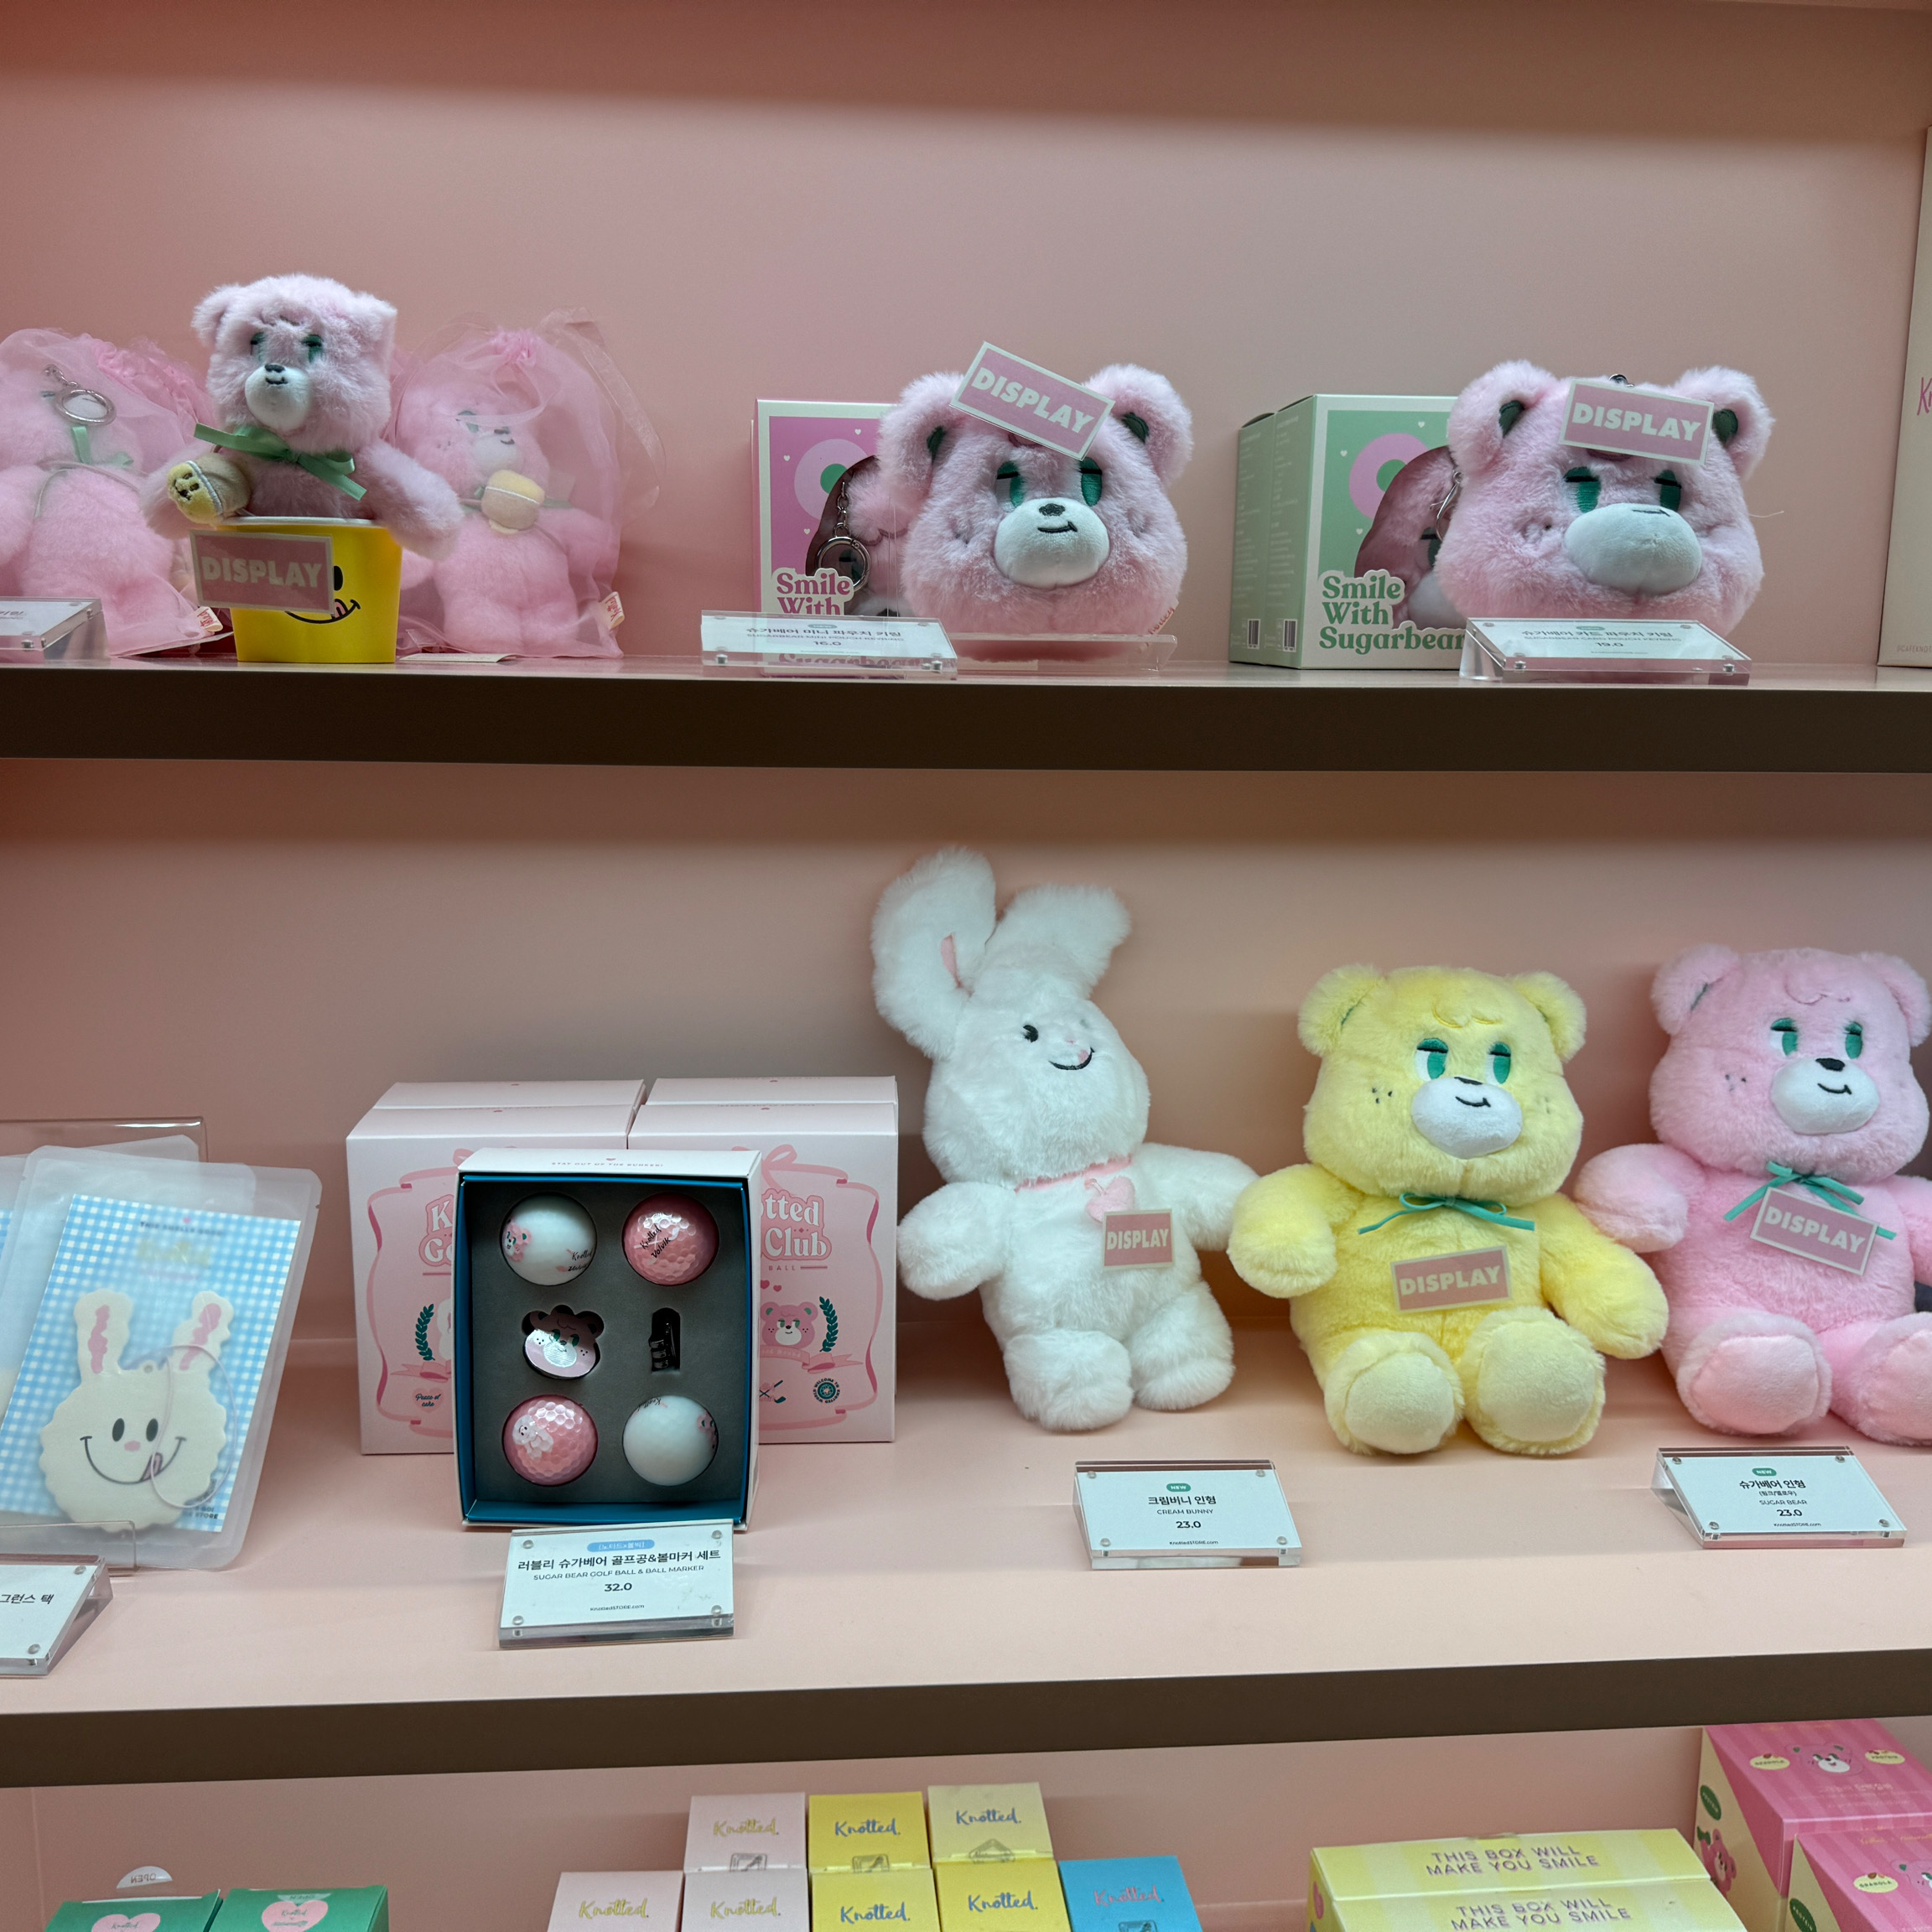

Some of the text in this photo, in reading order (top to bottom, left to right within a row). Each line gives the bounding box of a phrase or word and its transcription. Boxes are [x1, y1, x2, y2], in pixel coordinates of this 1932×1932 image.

[971, 367, 1094, 434] DISPLAY
[1572, 402, 1701, 441] DISPLAY
[201, 557, 322, 588] DISPLAY
[776, 572, 851, 595] Smile
[1322, 575, 1402, 599] Smile
[776, 596, 841, 615] With
[1322, 601, 1389, 625] With
[1319, 626, 1465, 655] Sugarbear
[640, 1223, 662, 1249] Knotted
[1107, 1228, 1170, 1250] DISPLAY
[1763, 1206, 1866, 1254] DISPLAY
[765, 1227, 827, 1257] Club
[1398, 1266, 1502, 1296] DISPLAY
[1739, 1479, 1806, 1489] 슈가베어 인형
[1148, 1495, 1217, 1506] 크림버니 인형
[1777, 1509, 1803, 1517] 23.0
[1176, 1520, 1202, 1530] 23.0
[517, 1550, 721, 1571] 러블리 슈가베어 골프공&볼마커 세트
[604, 1582, 632, 1592] 32.0
[41, 1594, 55, 1604] 택
[1432, 1846, 1581, 1863] THIS BOX WILL
[1426, 1855, 1599, 1877] MAKE YOU SMILE
[1457, 1898, 1613, 1917] THIS BOX WILL
[1451, 1908, 1632, 1931] MAKE YOU SMILE
